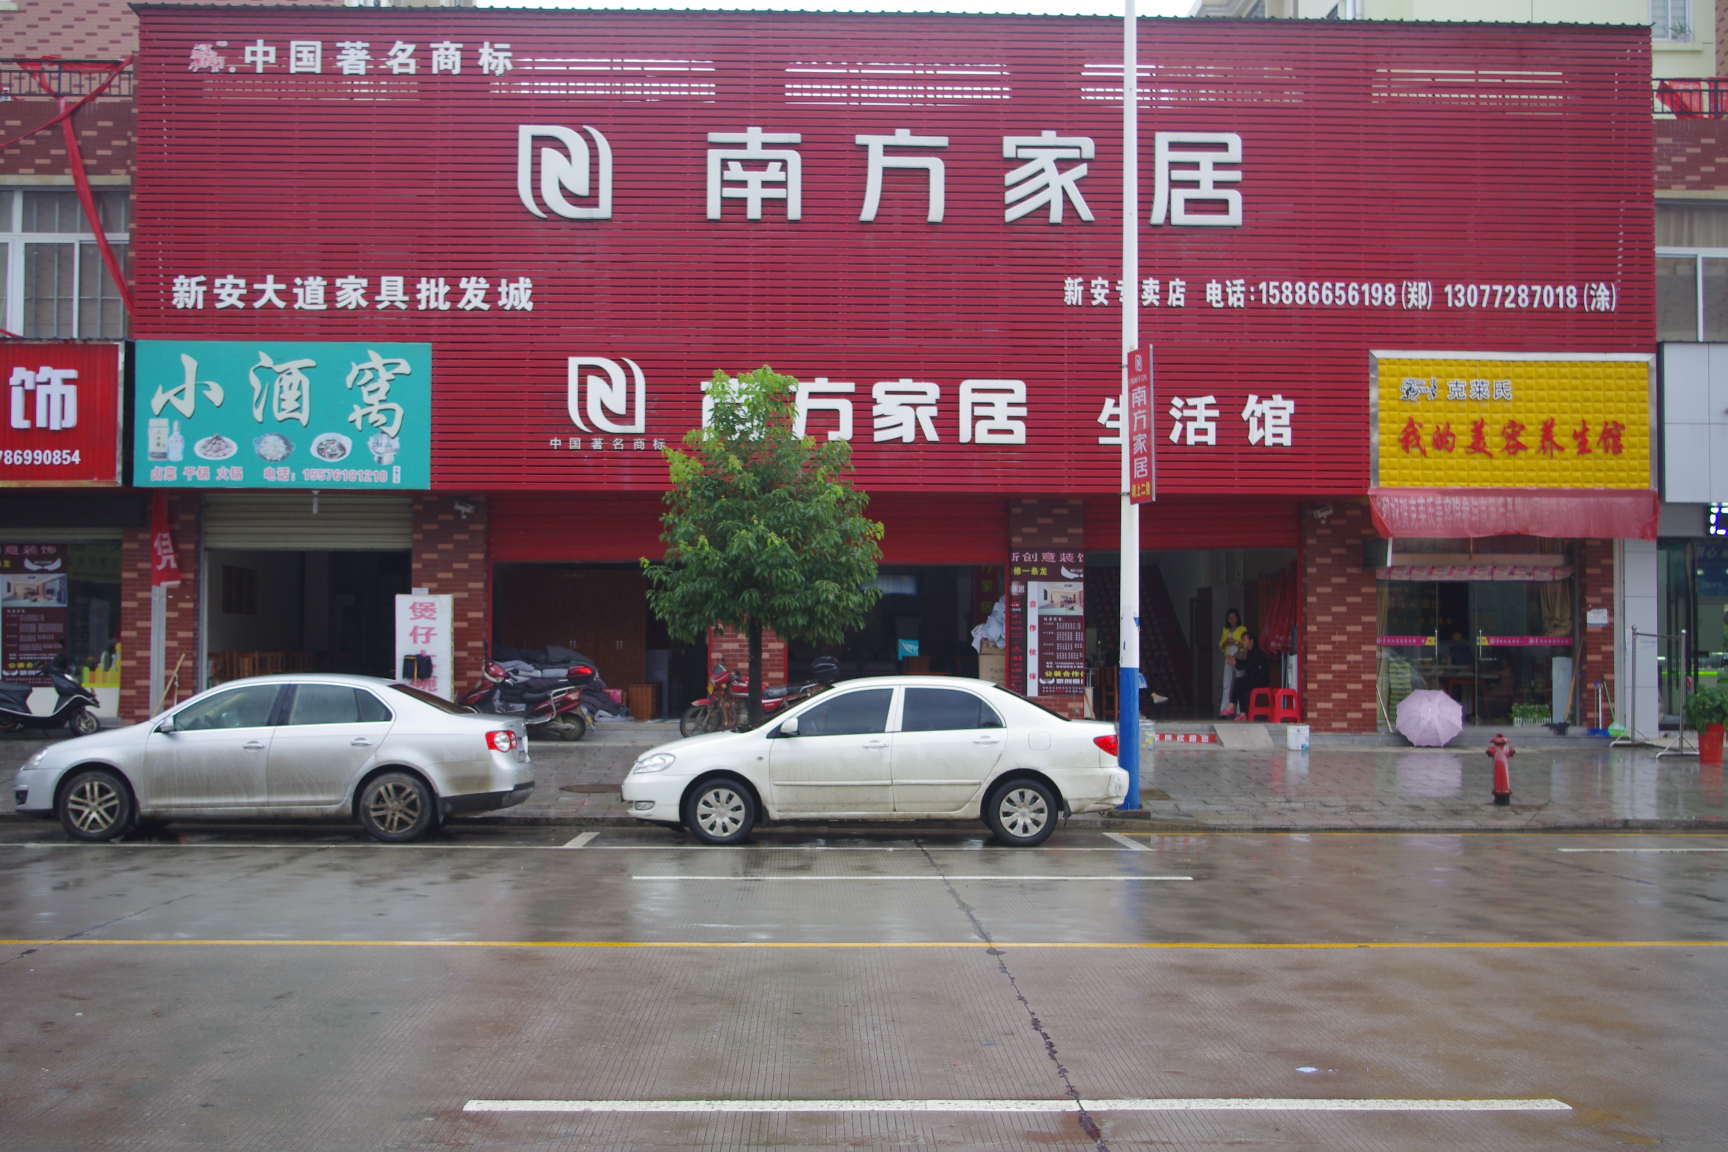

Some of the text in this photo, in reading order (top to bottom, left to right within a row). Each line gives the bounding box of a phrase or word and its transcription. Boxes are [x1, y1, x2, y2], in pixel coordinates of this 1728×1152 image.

[245, 39, 514, 76] 中国著名商标
[707, 126, 1243, 227] 南方家居
[171, 275, 534, 312] 新安大道家具批发城
[10, 366, 79, 431] 饰
[150, 350, 412, 438] 小酒窝
[1447, 378, 1512, 401] 克莱氏
[550, 437, 666, 450] 中国著名商标
[1131, 385, 1149, 479] 南方家居
[1398, 416, 1627, 460] 我的美容养生馆
[408, 601, 438, 693] 煲仔
